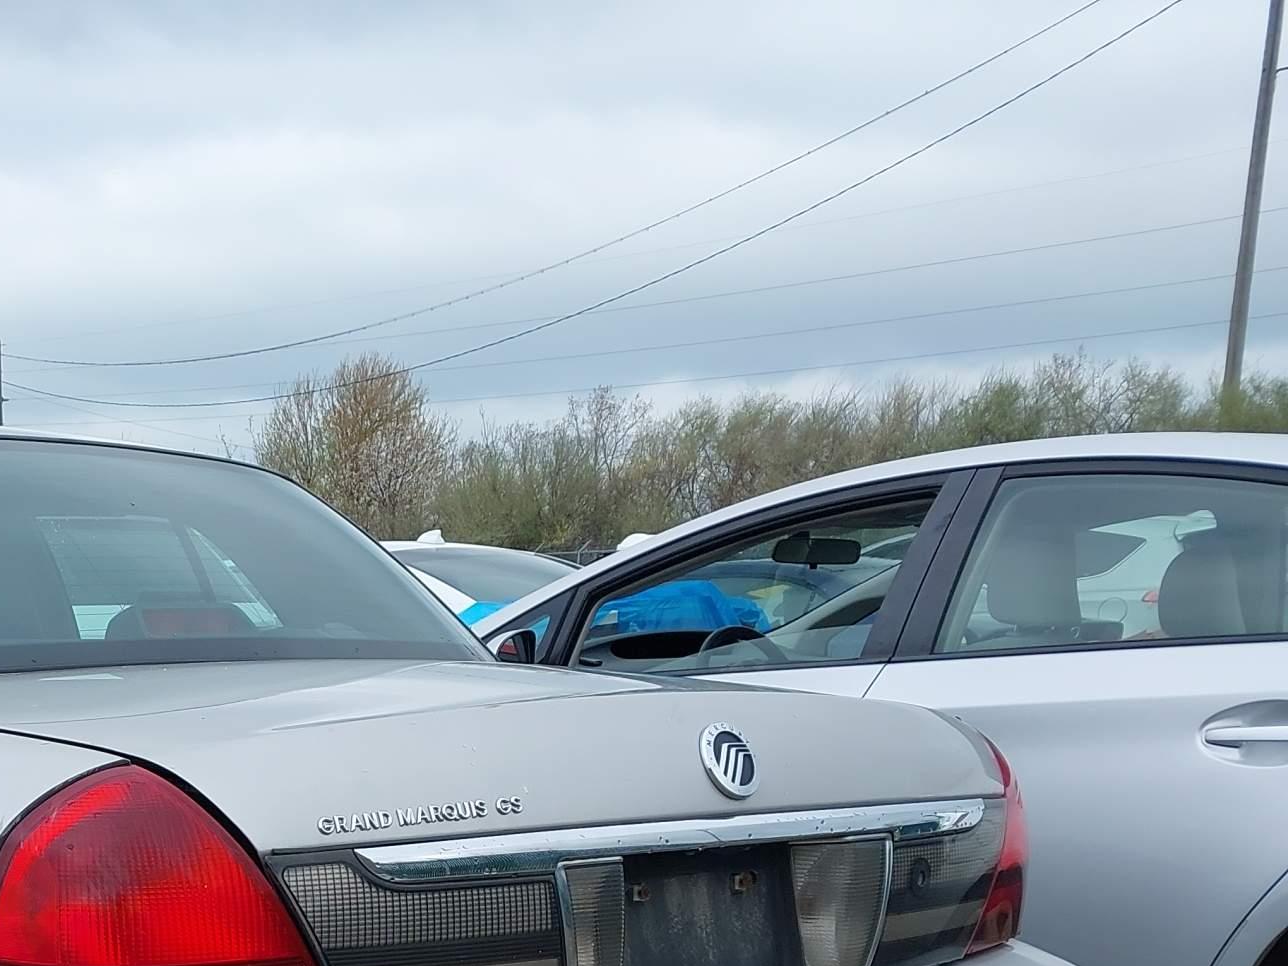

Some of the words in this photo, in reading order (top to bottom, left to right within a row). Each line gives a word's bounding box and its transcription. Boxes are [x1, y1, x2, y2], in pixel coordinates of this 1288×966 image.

[317, 808, 393, 835] GRAND
[396, 799, 488, 827] MARQUIS
[495, 796, 524, 816] GS
